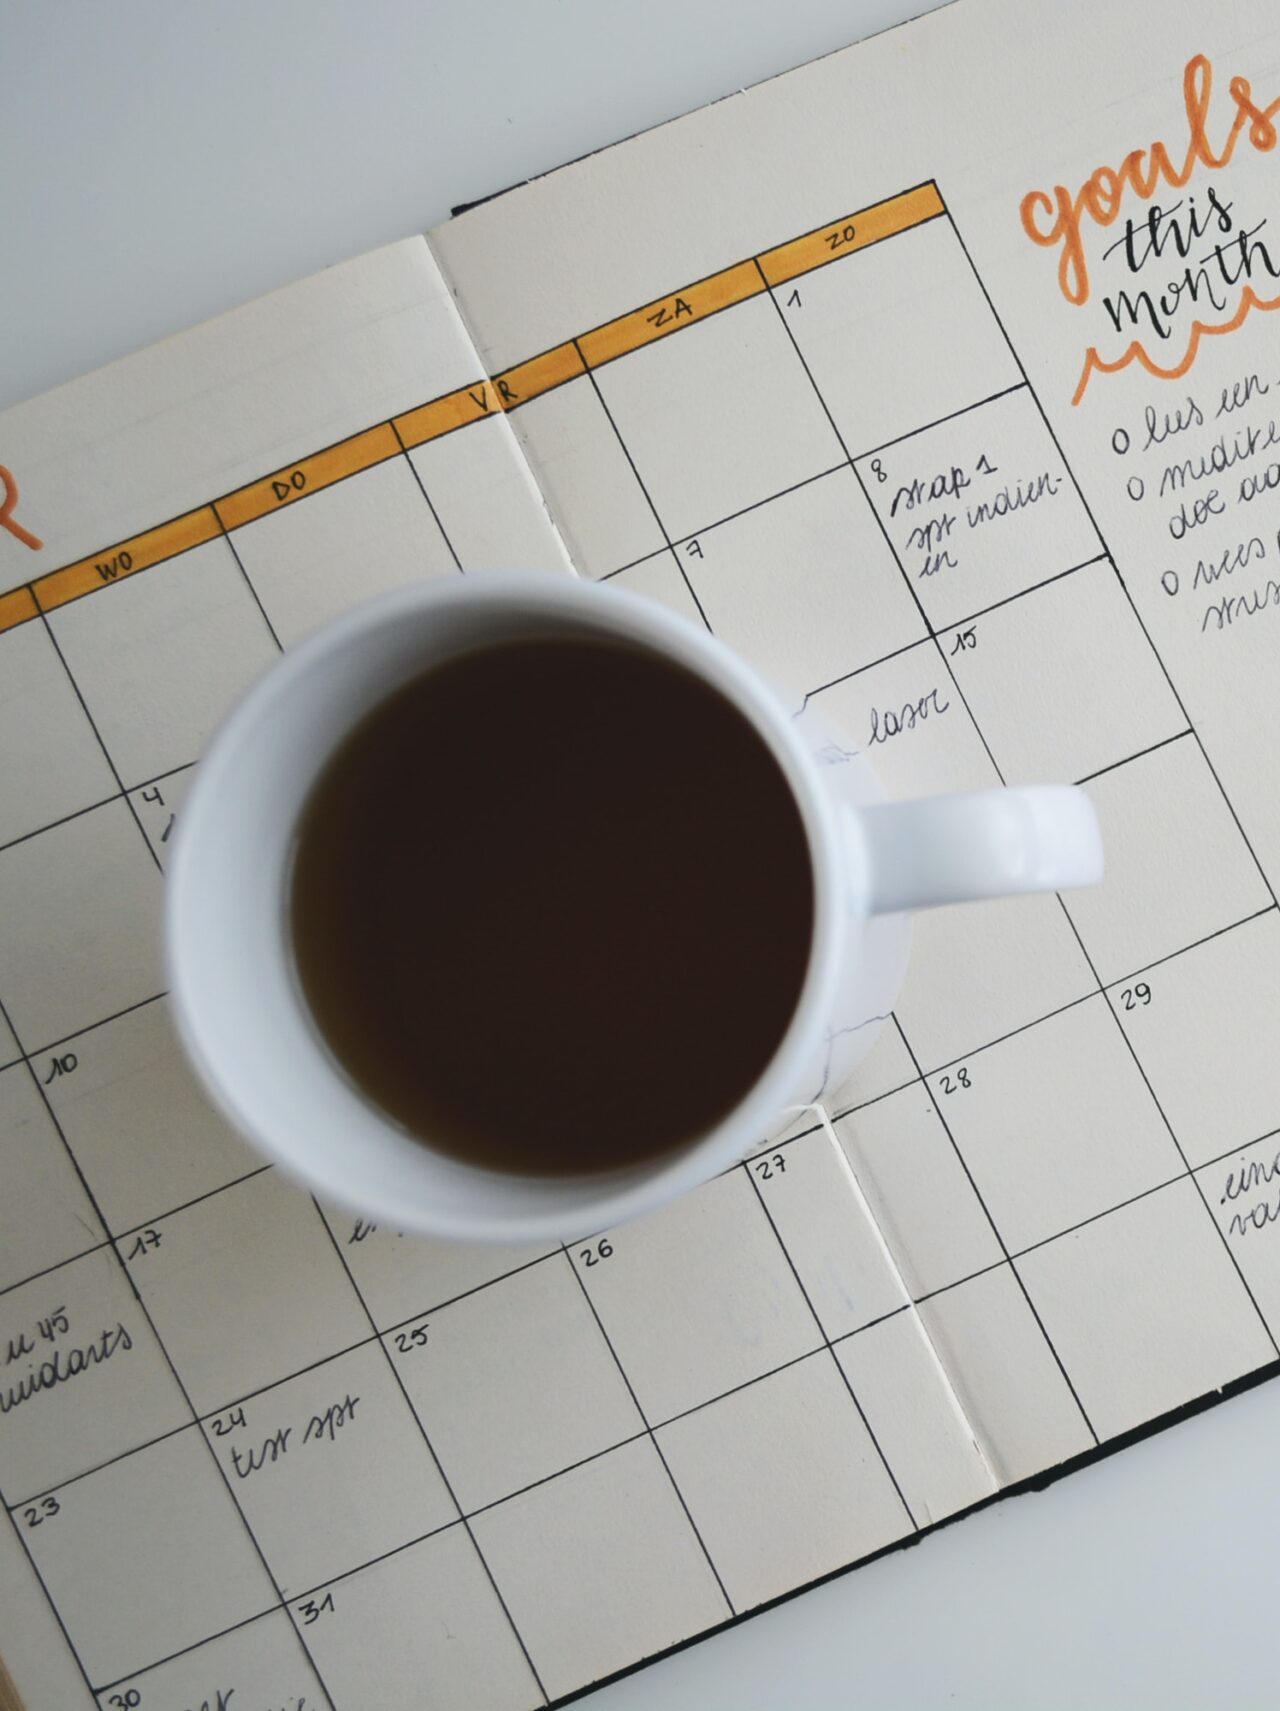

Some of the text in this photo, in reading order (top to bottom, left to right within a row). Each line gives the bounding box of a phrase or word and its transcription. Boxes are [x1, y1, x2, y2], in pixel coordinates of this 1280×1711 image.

[825, 225, 856, 250] ZO
[1102, 187, 1233, 272] this
[646, 297, 693, 328] ZA
[787, 289, 802, 308] 1
[870, 458, 888, 483] 8
[271, 471, 307, 501] DO
[1168, 488, 1226, 540] doe
[686, 540, 704, 559] 7
[95, 551, 133, 582] WO
[950, 625, 977, 656] 15
[142, 786, 165, 806] 4
[1121, 984, 1153, 1011] 29
[44, 1052, 79, 1085] 10
[940, 1067, 973, 1095] 28
[755, 1154, 788, 1181] 27
[127, 1230, 163, 1260] 17
[580, 1239, 615, 1269] 26
[37, 1305, 70, 1343] 45
[394, 1325, 430, 1353] 25
[211, 1408, 247, 1437] 24
[24, 1496, 61, 1529] 23
[298, 1593, 336, 1626] 31
